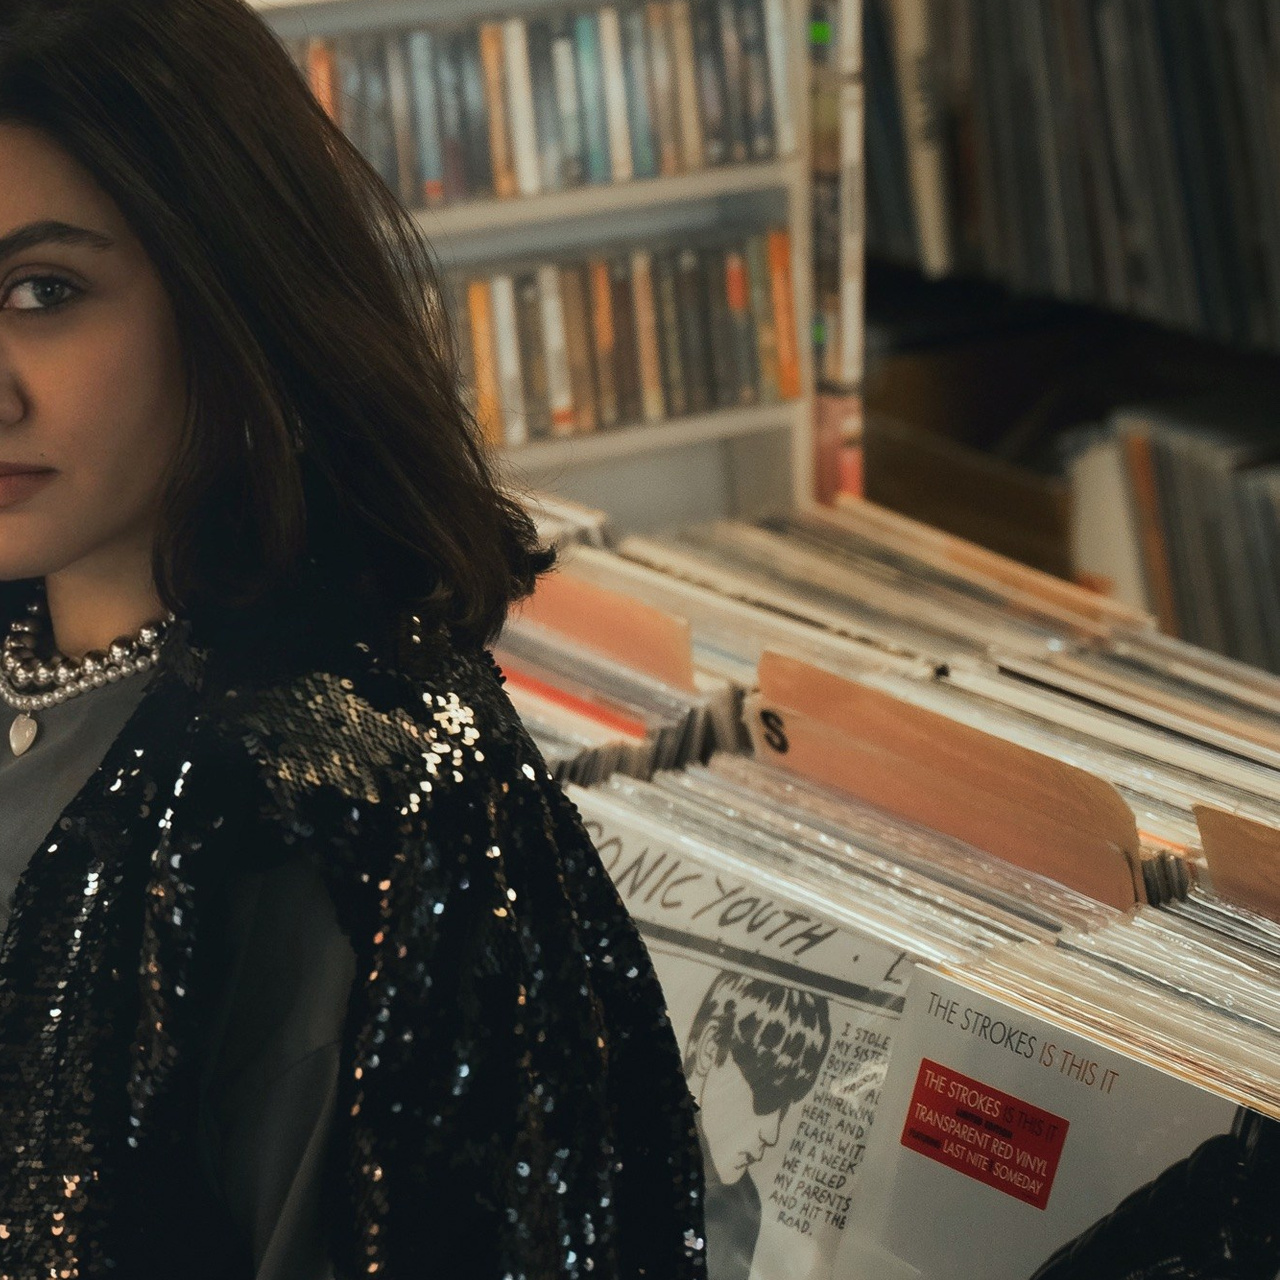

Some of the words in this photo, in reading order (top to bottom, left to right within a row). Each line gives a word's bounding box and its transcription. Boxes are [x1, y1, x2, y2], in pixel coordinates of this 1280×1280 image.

[760, 709, 789, 754] S
[692, 877, 838, 956] YOUTH
[832, 1040, 852, 1057] MY
[841, 1022, 851, 1037] I
[854, 1027, 891, 1051] STOLE
[927, 991, 960, 1025] THE
[960, 1008, 1037, 1059] STROKES
[1038, 1041, 1056, 1067] IS
[1060, 1050, 1098, 1086] THIS
[1100, 1068, 1120, 1094] IT
[822, 1070, 837, 1087] IT
[923, 1070, 948, 1094] THE
[948, 1081, 1001, 1118] STROKES
[835, 1120, 864, 1141] AND
[914, 1103, 991, 1150] TRANSPARENT
[991, 1138, 1014, 1160] RED
[1016, 1148, 1048, 1177] VINYL
[789, 1139, 805, 1155] IN
[808, 1145, 816, 1161] A
[821, 1151, 858, 1175] WEEK
[838, 1140, 866, 1162] WIT
[943, 1139, 966, 1159] LAST
[966, 1150, 988, 1171] NITE
[992, 1162, 1045, 1195] SOMEDAY
[782, 1154, 801, 1174] WE
[802, 1164, 847, 1190] KILLED
[770, 1191, 797, 1210] AND
[800, 1203, 822, 1219] HIT
[825, 1210, 847, 1230] THE
[774, 1173, 793, 1191] MY
[795, 1181, 852, 1212] PARENTS
